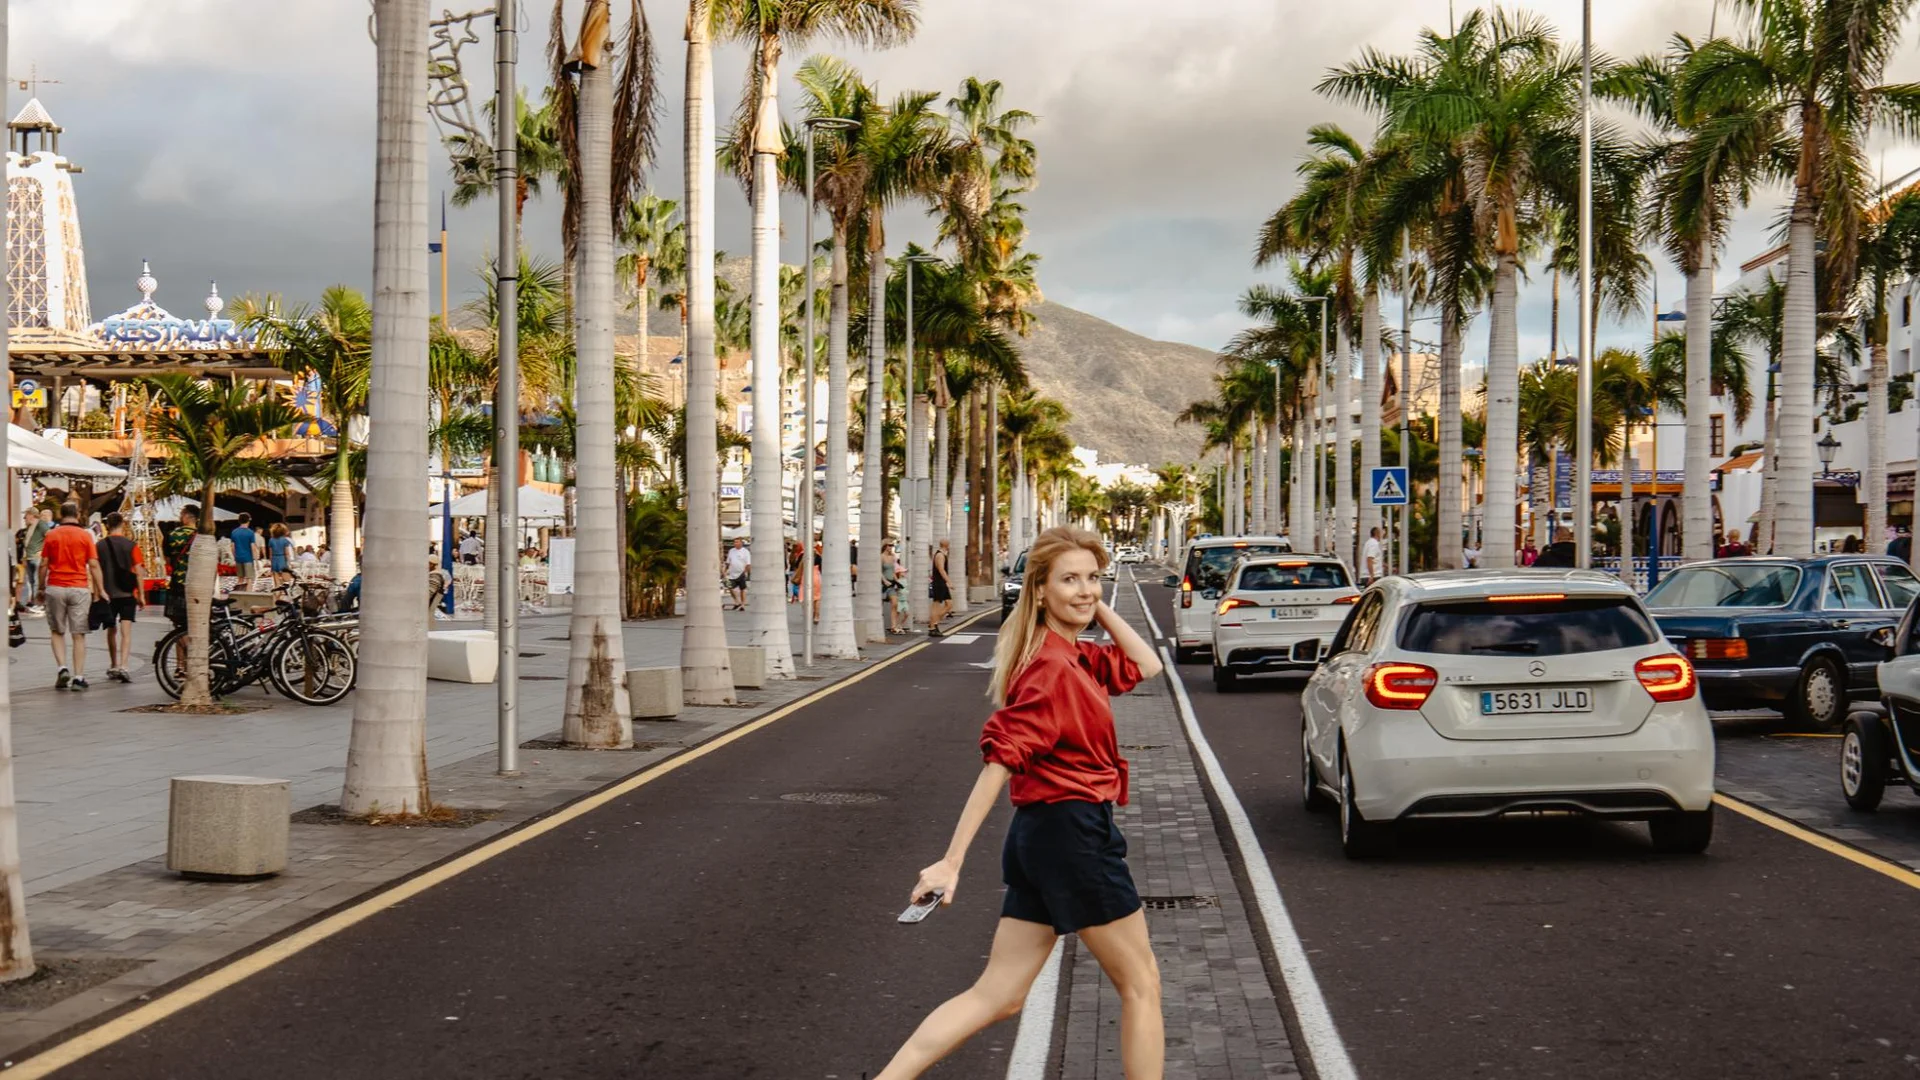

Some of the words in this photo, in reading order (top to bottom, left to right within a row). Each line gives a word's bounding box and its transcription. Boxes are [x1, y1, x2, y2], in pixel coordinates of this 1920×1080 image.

[1591, 472, 1619, 480] FUMES
[1645, 472, 1676, 480] BAUTY
[1495, 692, 1541, 710] 5631
[1552, 691, 1588, 709] JLD
